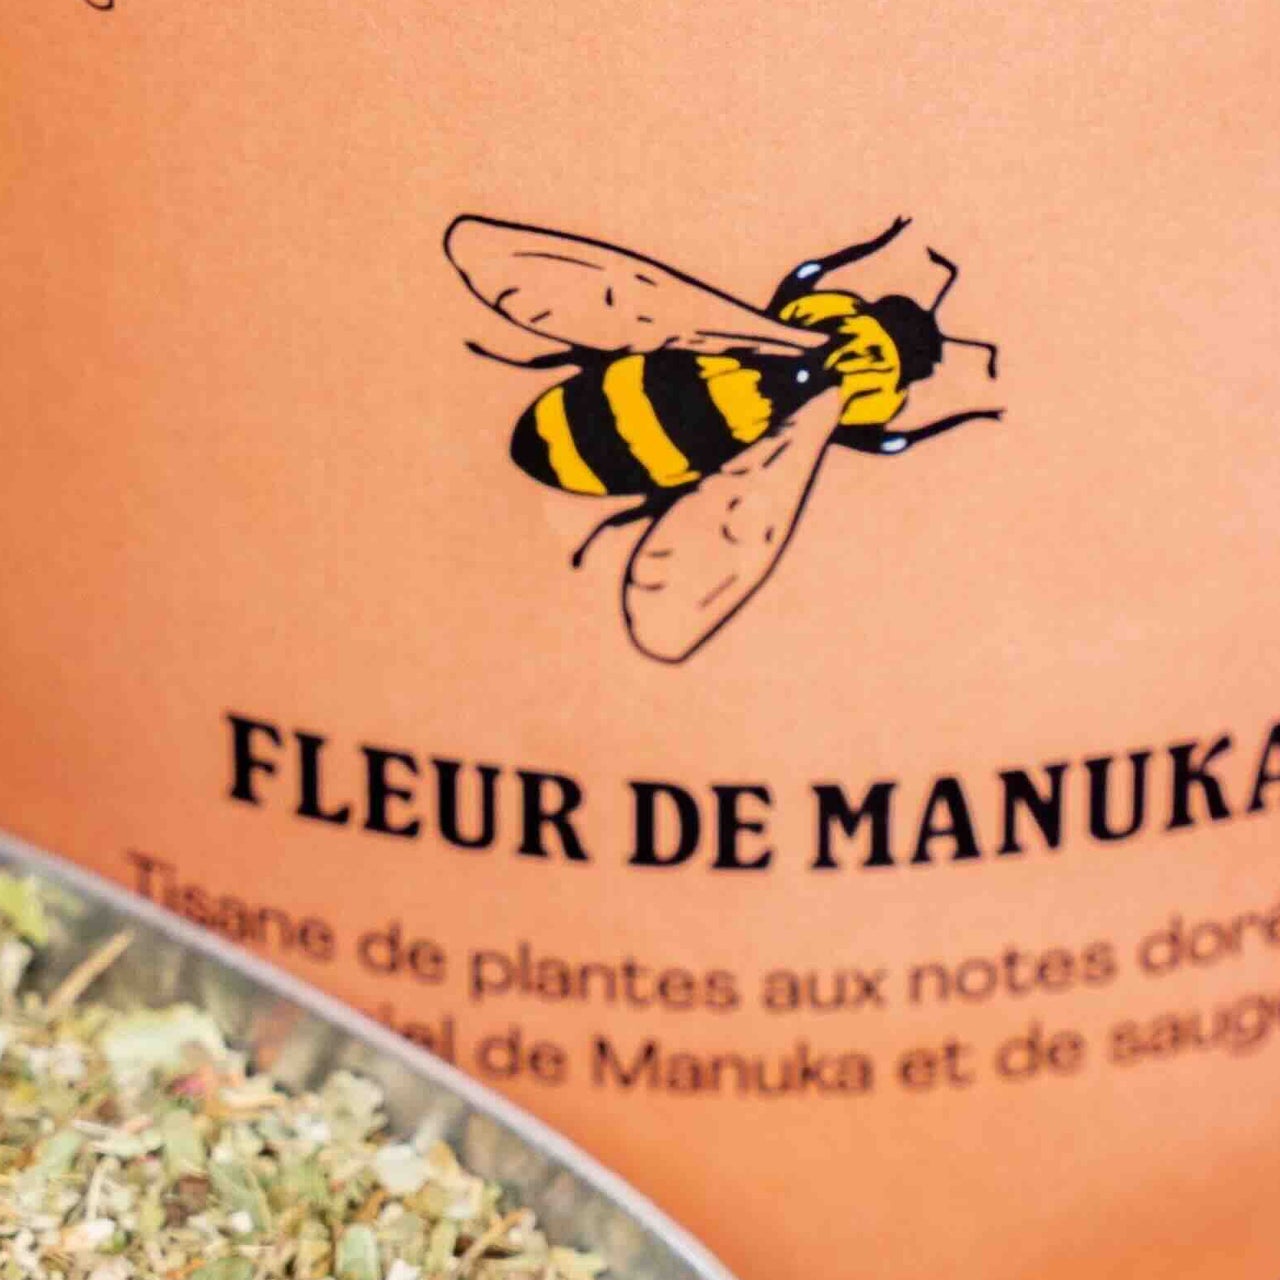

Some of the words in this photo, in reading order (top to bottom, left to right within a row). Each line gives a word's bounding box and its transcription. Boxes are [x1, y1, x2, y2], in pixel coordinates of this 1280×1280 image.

[227, 713, 590, 862] FLEUR
[628, 780, 774, 870] DE
[125, 848, 336, 964] Tisane
[357, 920, 446, 984] de
[469, 942, 740, 1012] plantes
[762, 967, 887, 1013] aux
[908, 942, 1117, 1004] notes
[476, 1023, 568, 1084] de
[591, 1033, 875, 1097] Manuka
[898, 1039, 974, 1092] et
[995, 1018, 1085, 1080] de
